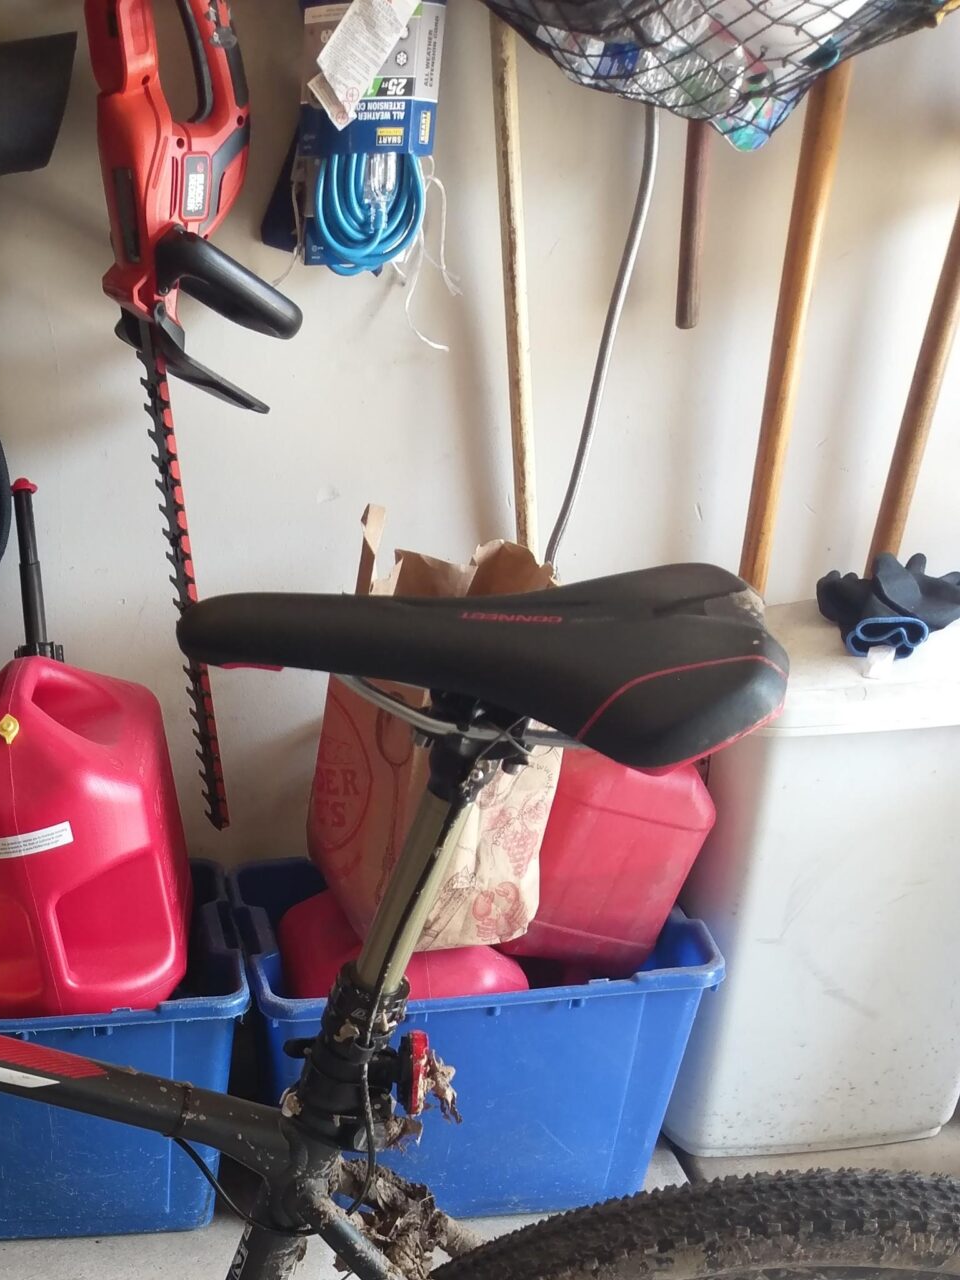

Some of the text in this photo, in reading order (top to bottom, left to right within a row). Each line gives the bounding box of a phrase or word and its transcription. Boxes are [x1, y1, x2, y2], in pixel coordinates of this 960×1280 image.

[386, 78, 407, 96] 25
[367, 101, 406, 111] EXTENSION
[358, 111, 405, 121] ALL WEATHER
[378, 135, 402, 144] SMART
[460, 610, 564, 625] CONNECT
